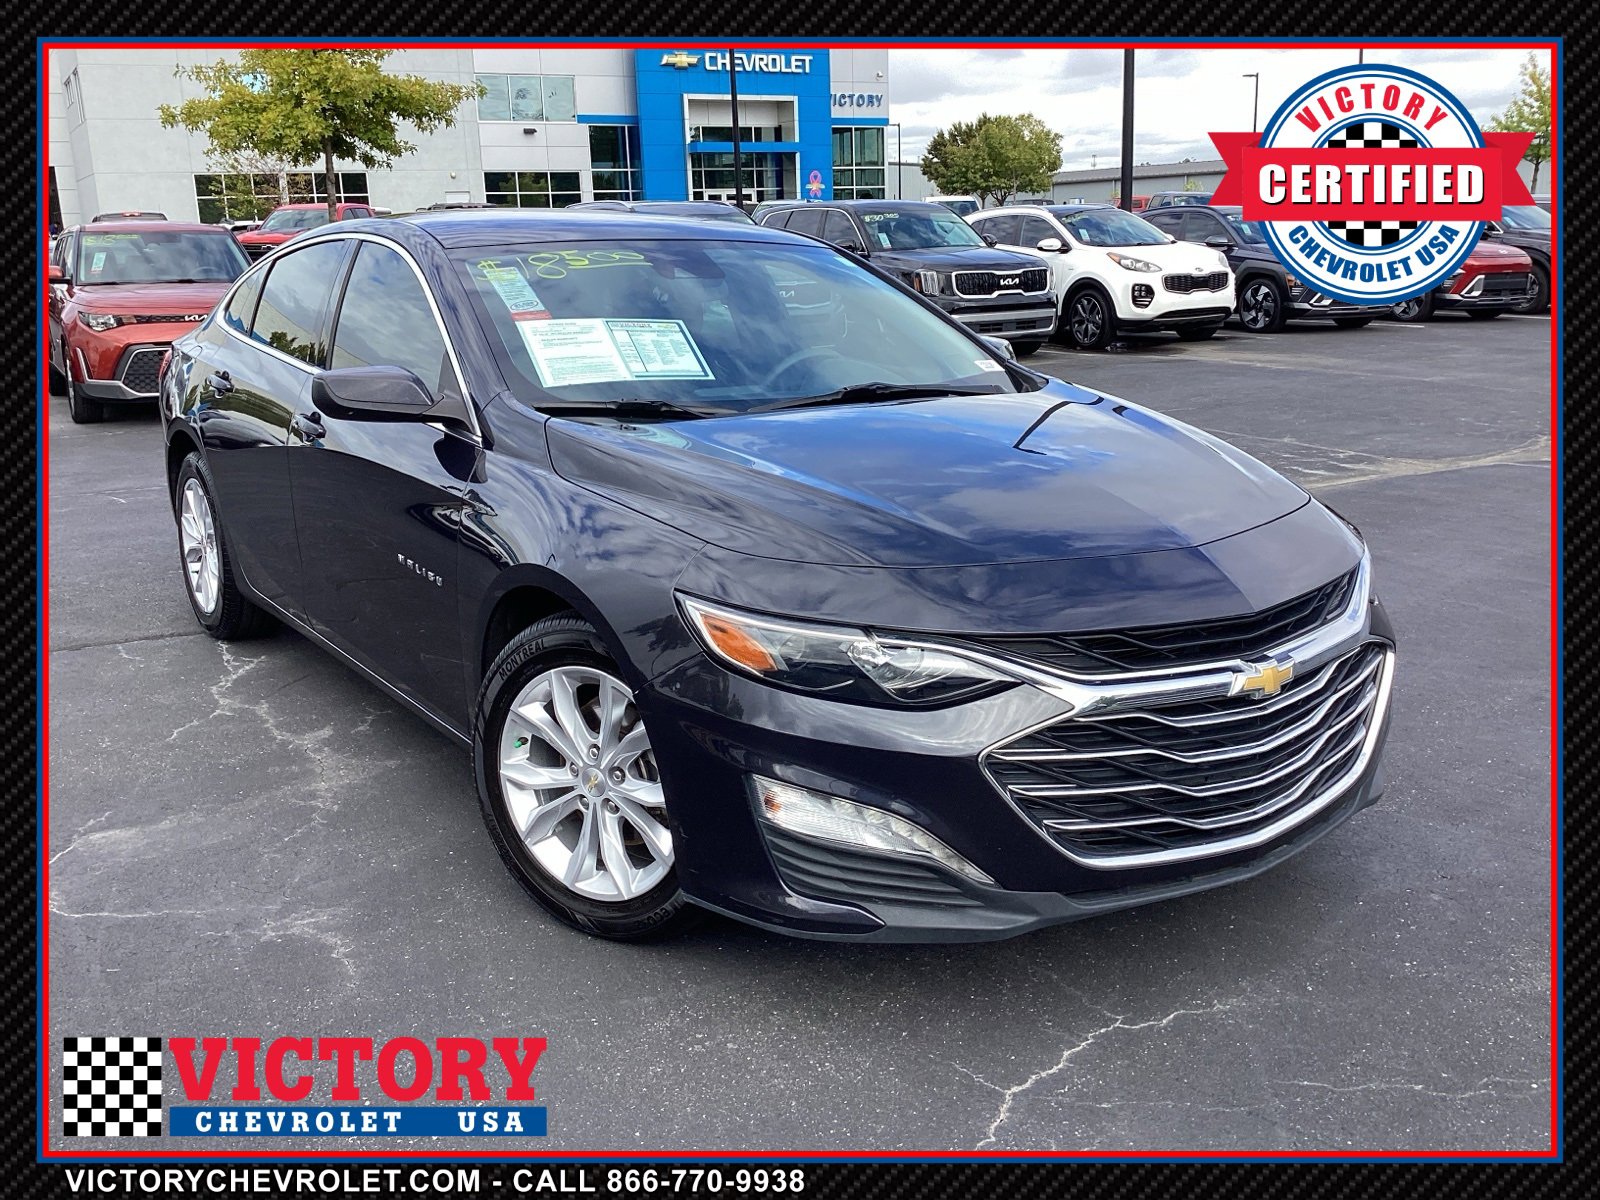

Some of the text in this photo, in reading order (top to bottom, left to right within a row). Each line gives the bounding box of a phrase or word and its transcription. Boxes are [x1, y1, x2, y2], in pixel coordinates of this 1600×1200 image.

[704, 52, 813, 73] CHEVROLET
[830, 93, 883, 108] ICTORY
[498, 638, 548, 681] MONTREAL
